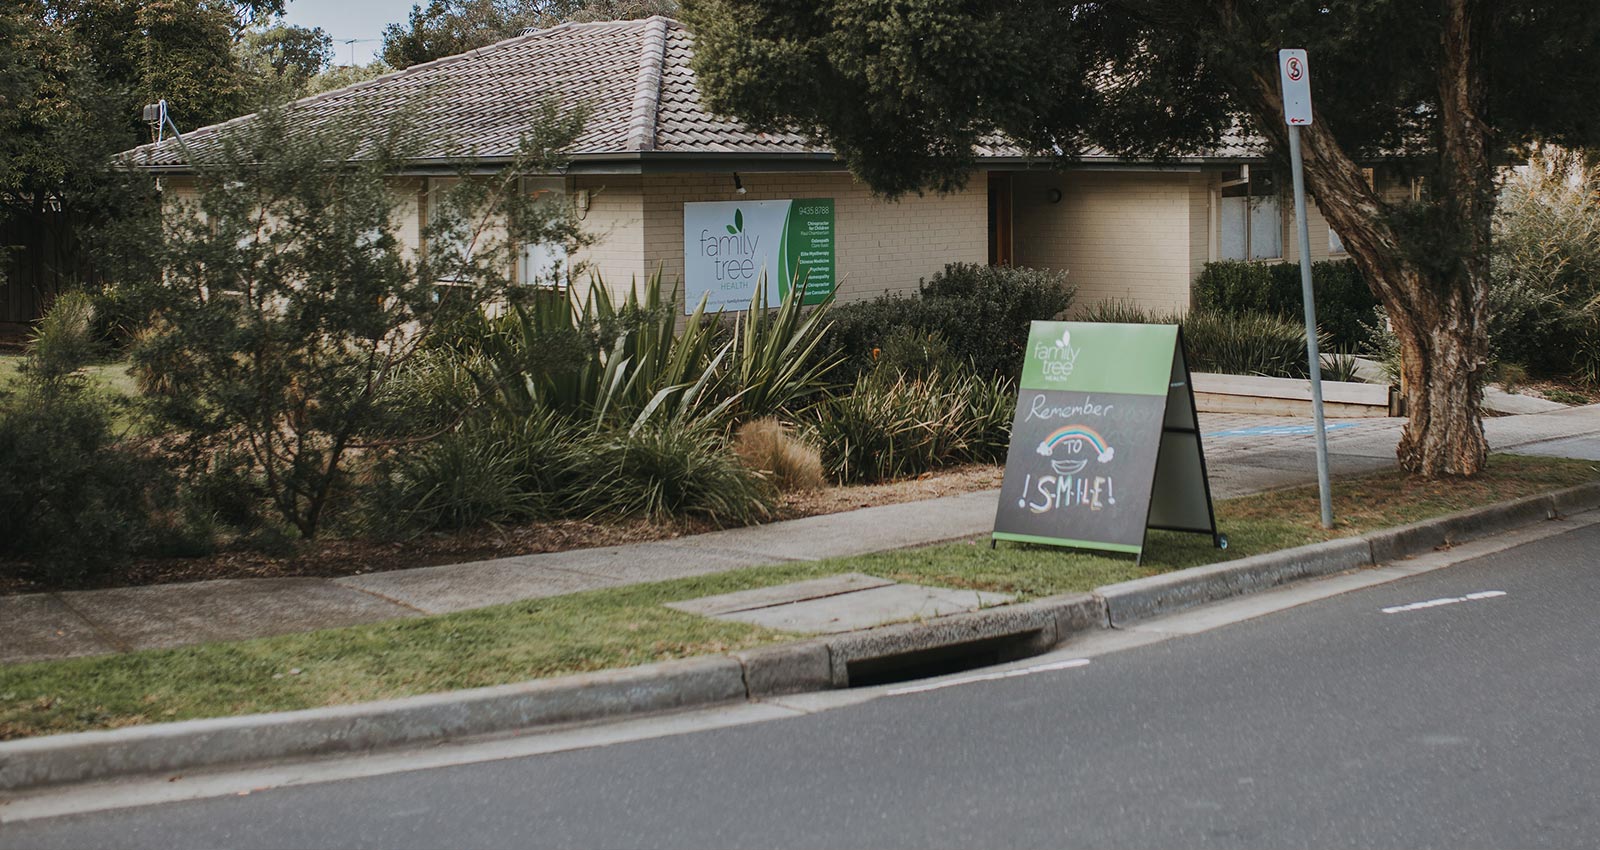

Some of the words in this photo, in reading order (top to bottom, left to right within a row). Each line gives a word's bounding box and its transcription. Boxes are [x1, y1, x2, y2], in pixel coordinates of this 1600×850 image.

[799, 206, 814, 215] 9435
[815, 206, 829, 215] 8788
[700, 229, 759, 260] family
[715, 257, 754, 280] tree
[720, 281, 748, 290] HEALTH
[1034, 341, 1080, 363] family
[1042, 359, 1073, 375] tree
[1025, 394, 1113, 422] Remember
[1064, 439, 1082, 454] TO
